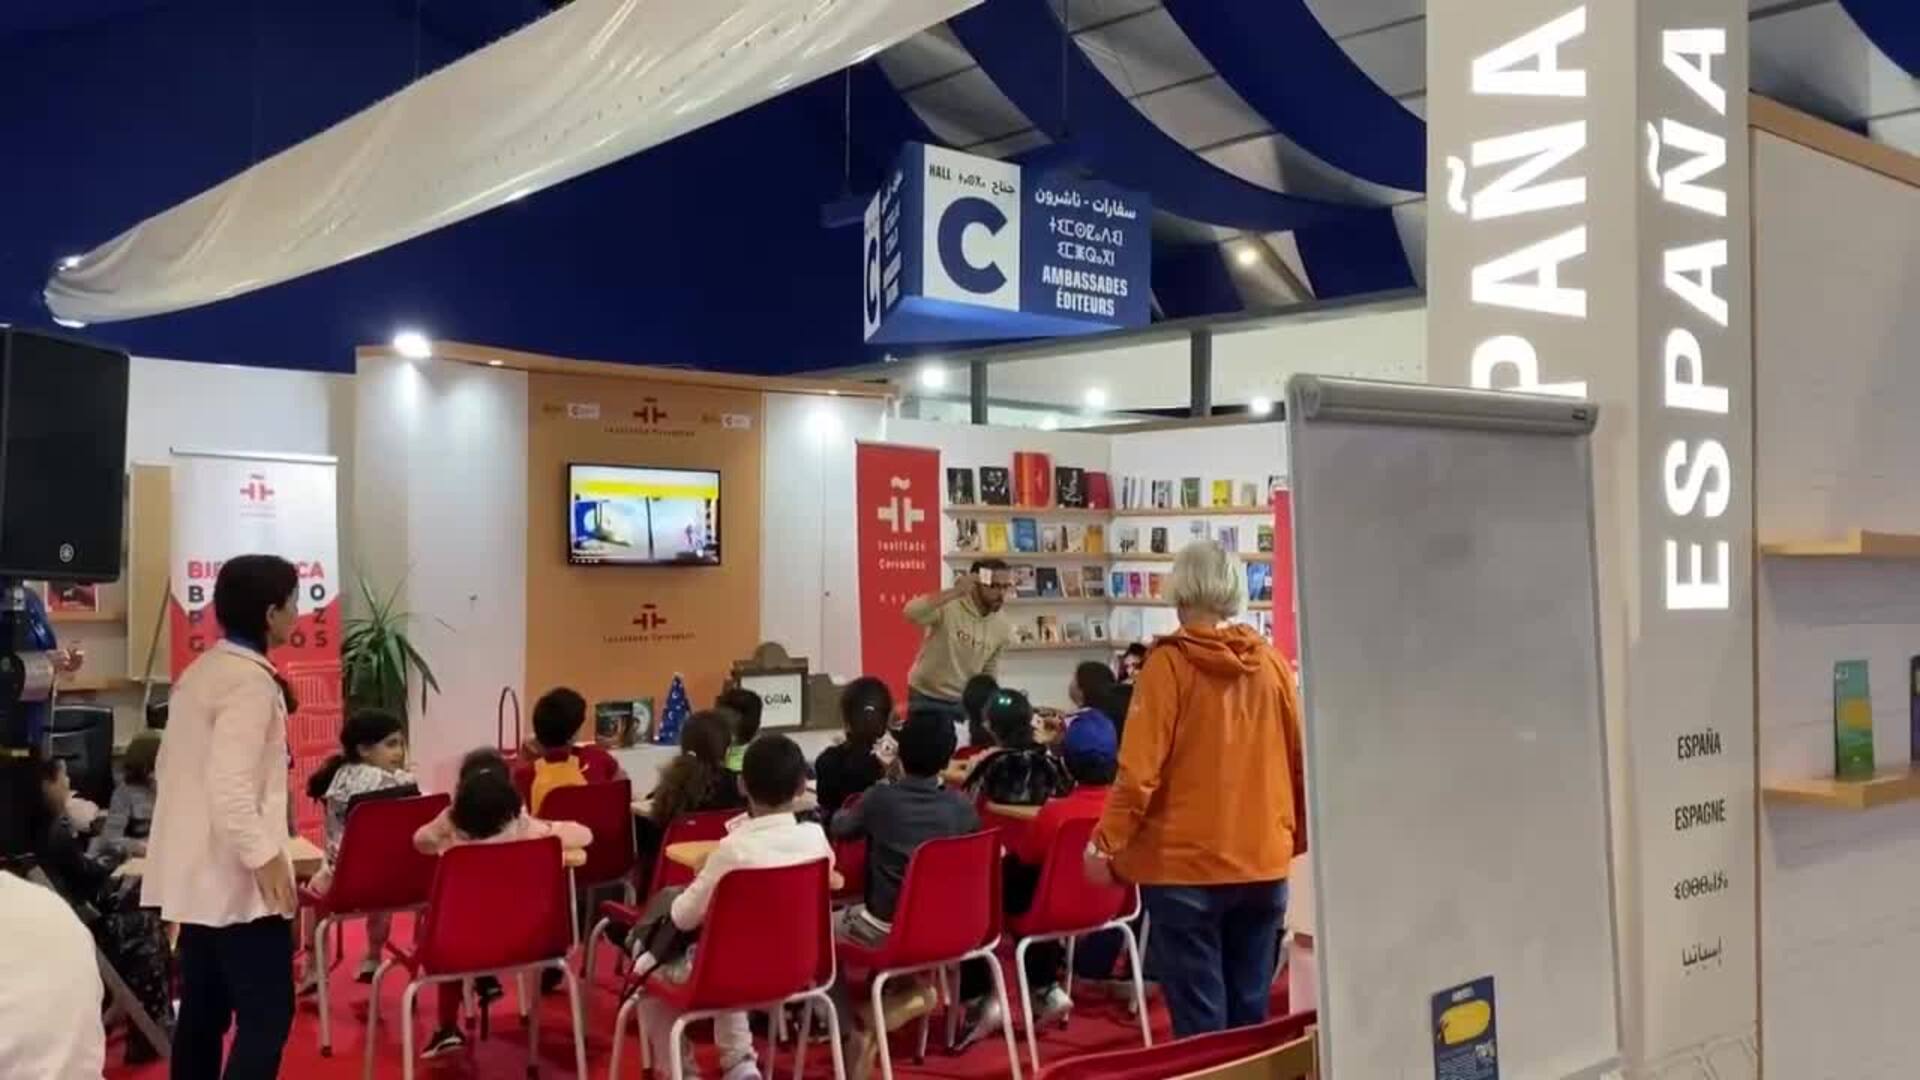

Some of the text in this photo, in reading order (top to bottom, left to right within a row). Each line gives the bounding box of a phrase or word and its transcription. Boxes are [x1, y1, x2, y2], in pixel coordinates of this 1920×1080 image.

[929, 163, 951, 181] HALL
[991, 180, 1016, 196] جناح
[1035, 188, 1080, 207] ناشرون
[1092, 198, 1136, 219] سفارات
[1446, 4, 1587, 400] PAÑA
[937, 196, 1008, 295] C
[1042, 265, 1128, 297] AMBASSADES
[1056, 287, 1116, 316] ÉDITEURS
[1647, 28, 1732, 610] ESPAÑA
[1677, 728, 1722, 760] ESPAÑA
[1674, 799, 1727, 831] ESPAGNE
[1682, 936, 1722, 976] إسبانيا
